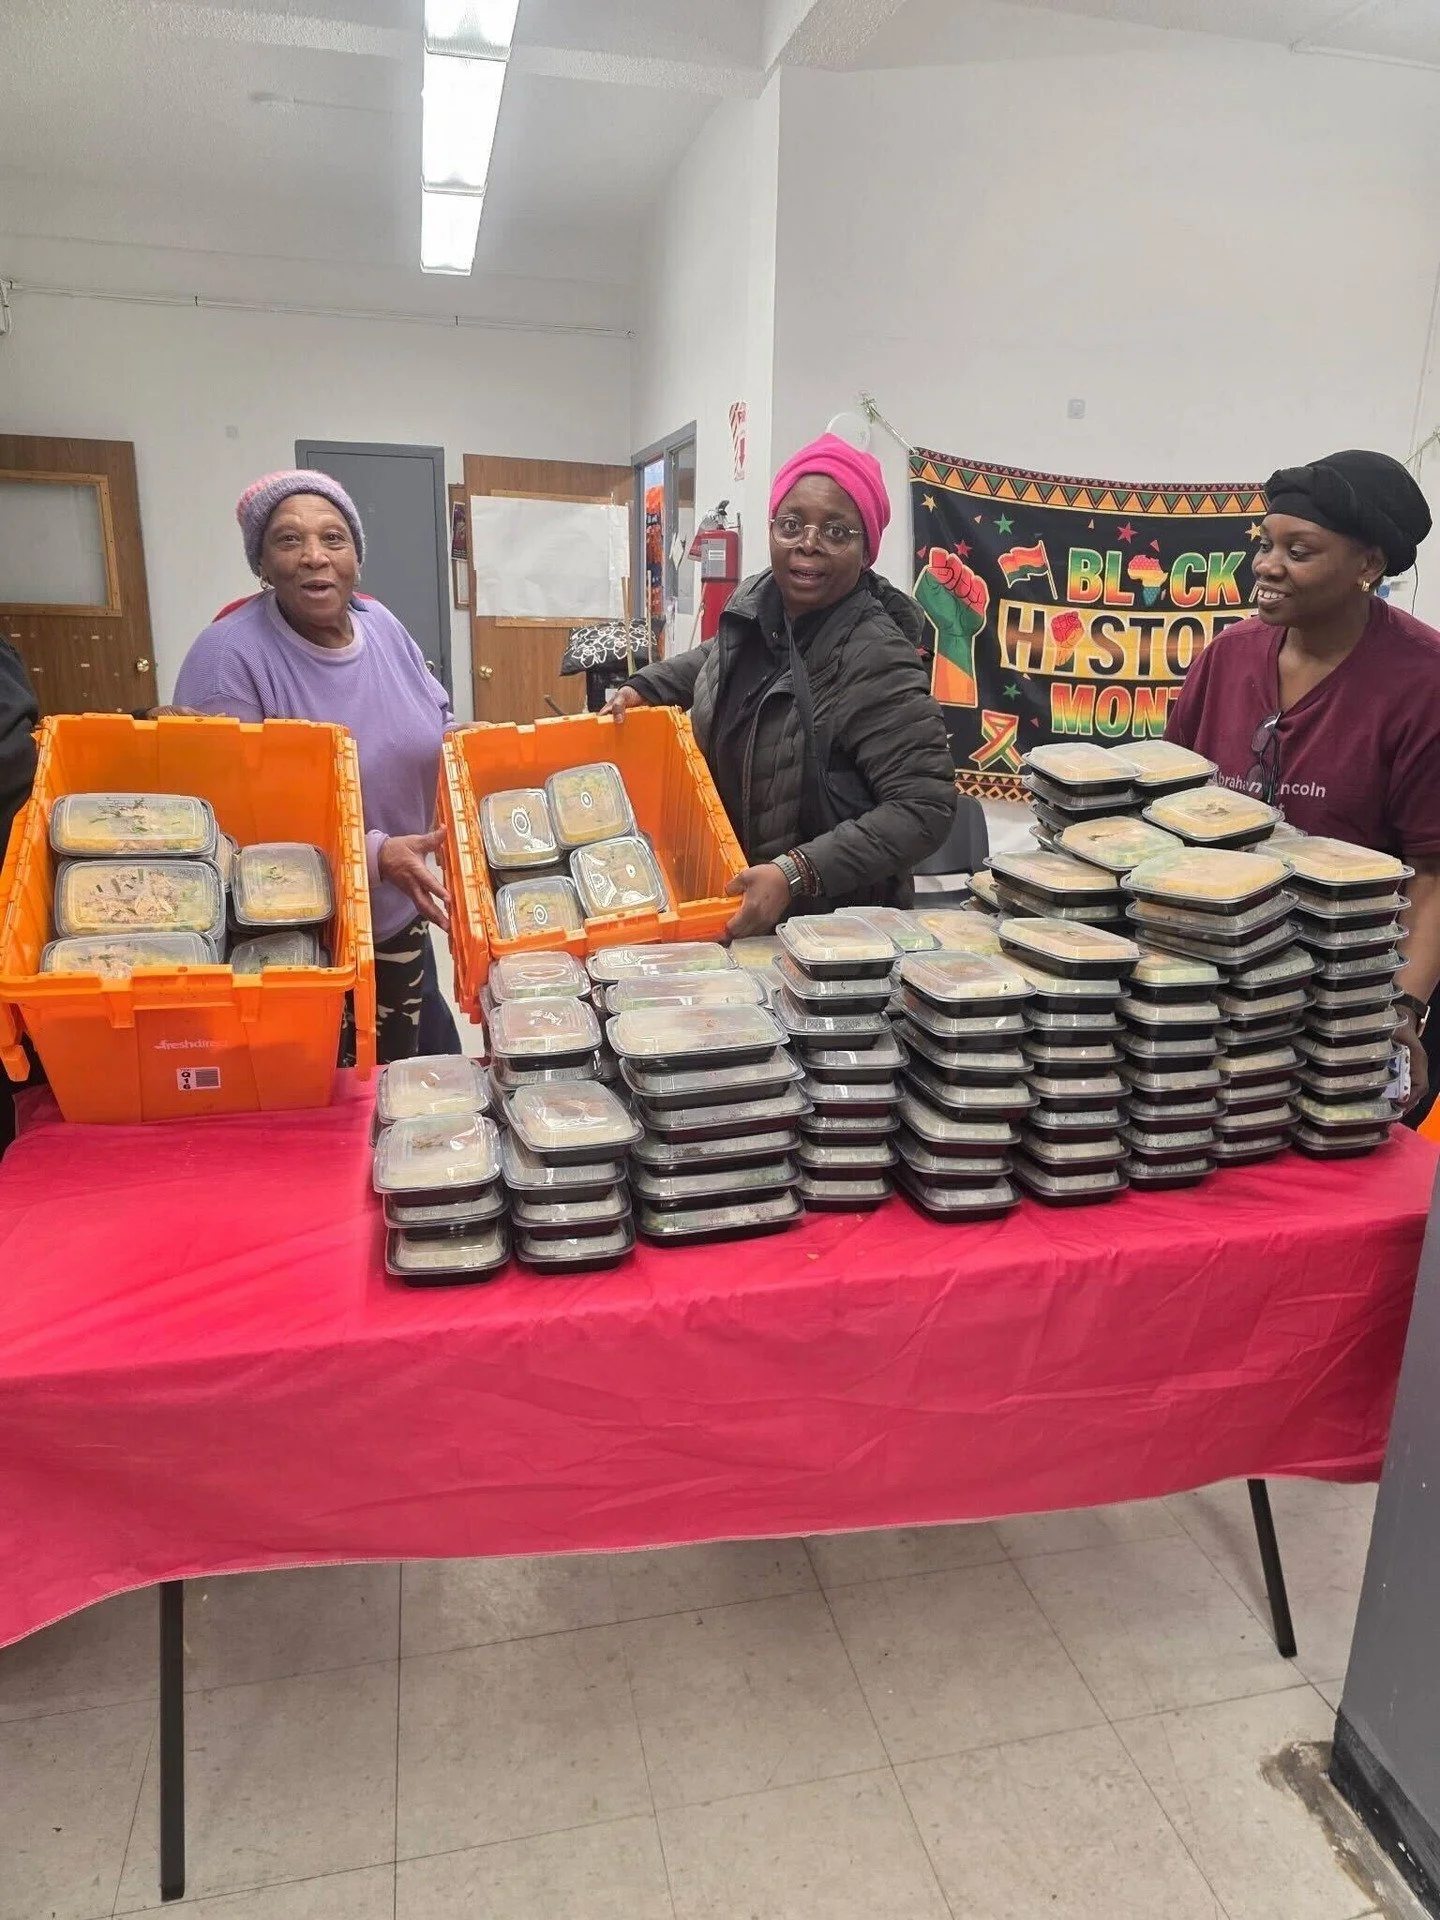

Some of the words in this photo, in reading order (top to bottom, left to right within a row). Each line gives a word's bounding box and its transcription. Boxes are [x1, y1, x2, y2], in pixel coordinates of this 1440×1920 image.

[1066, 547, 1246, 607] BLCK
[1004, 604, 1245, 677] HSTO
[1050, 682, 1182, 737] MON
[1274, 780, 1326, 798] ncoln
